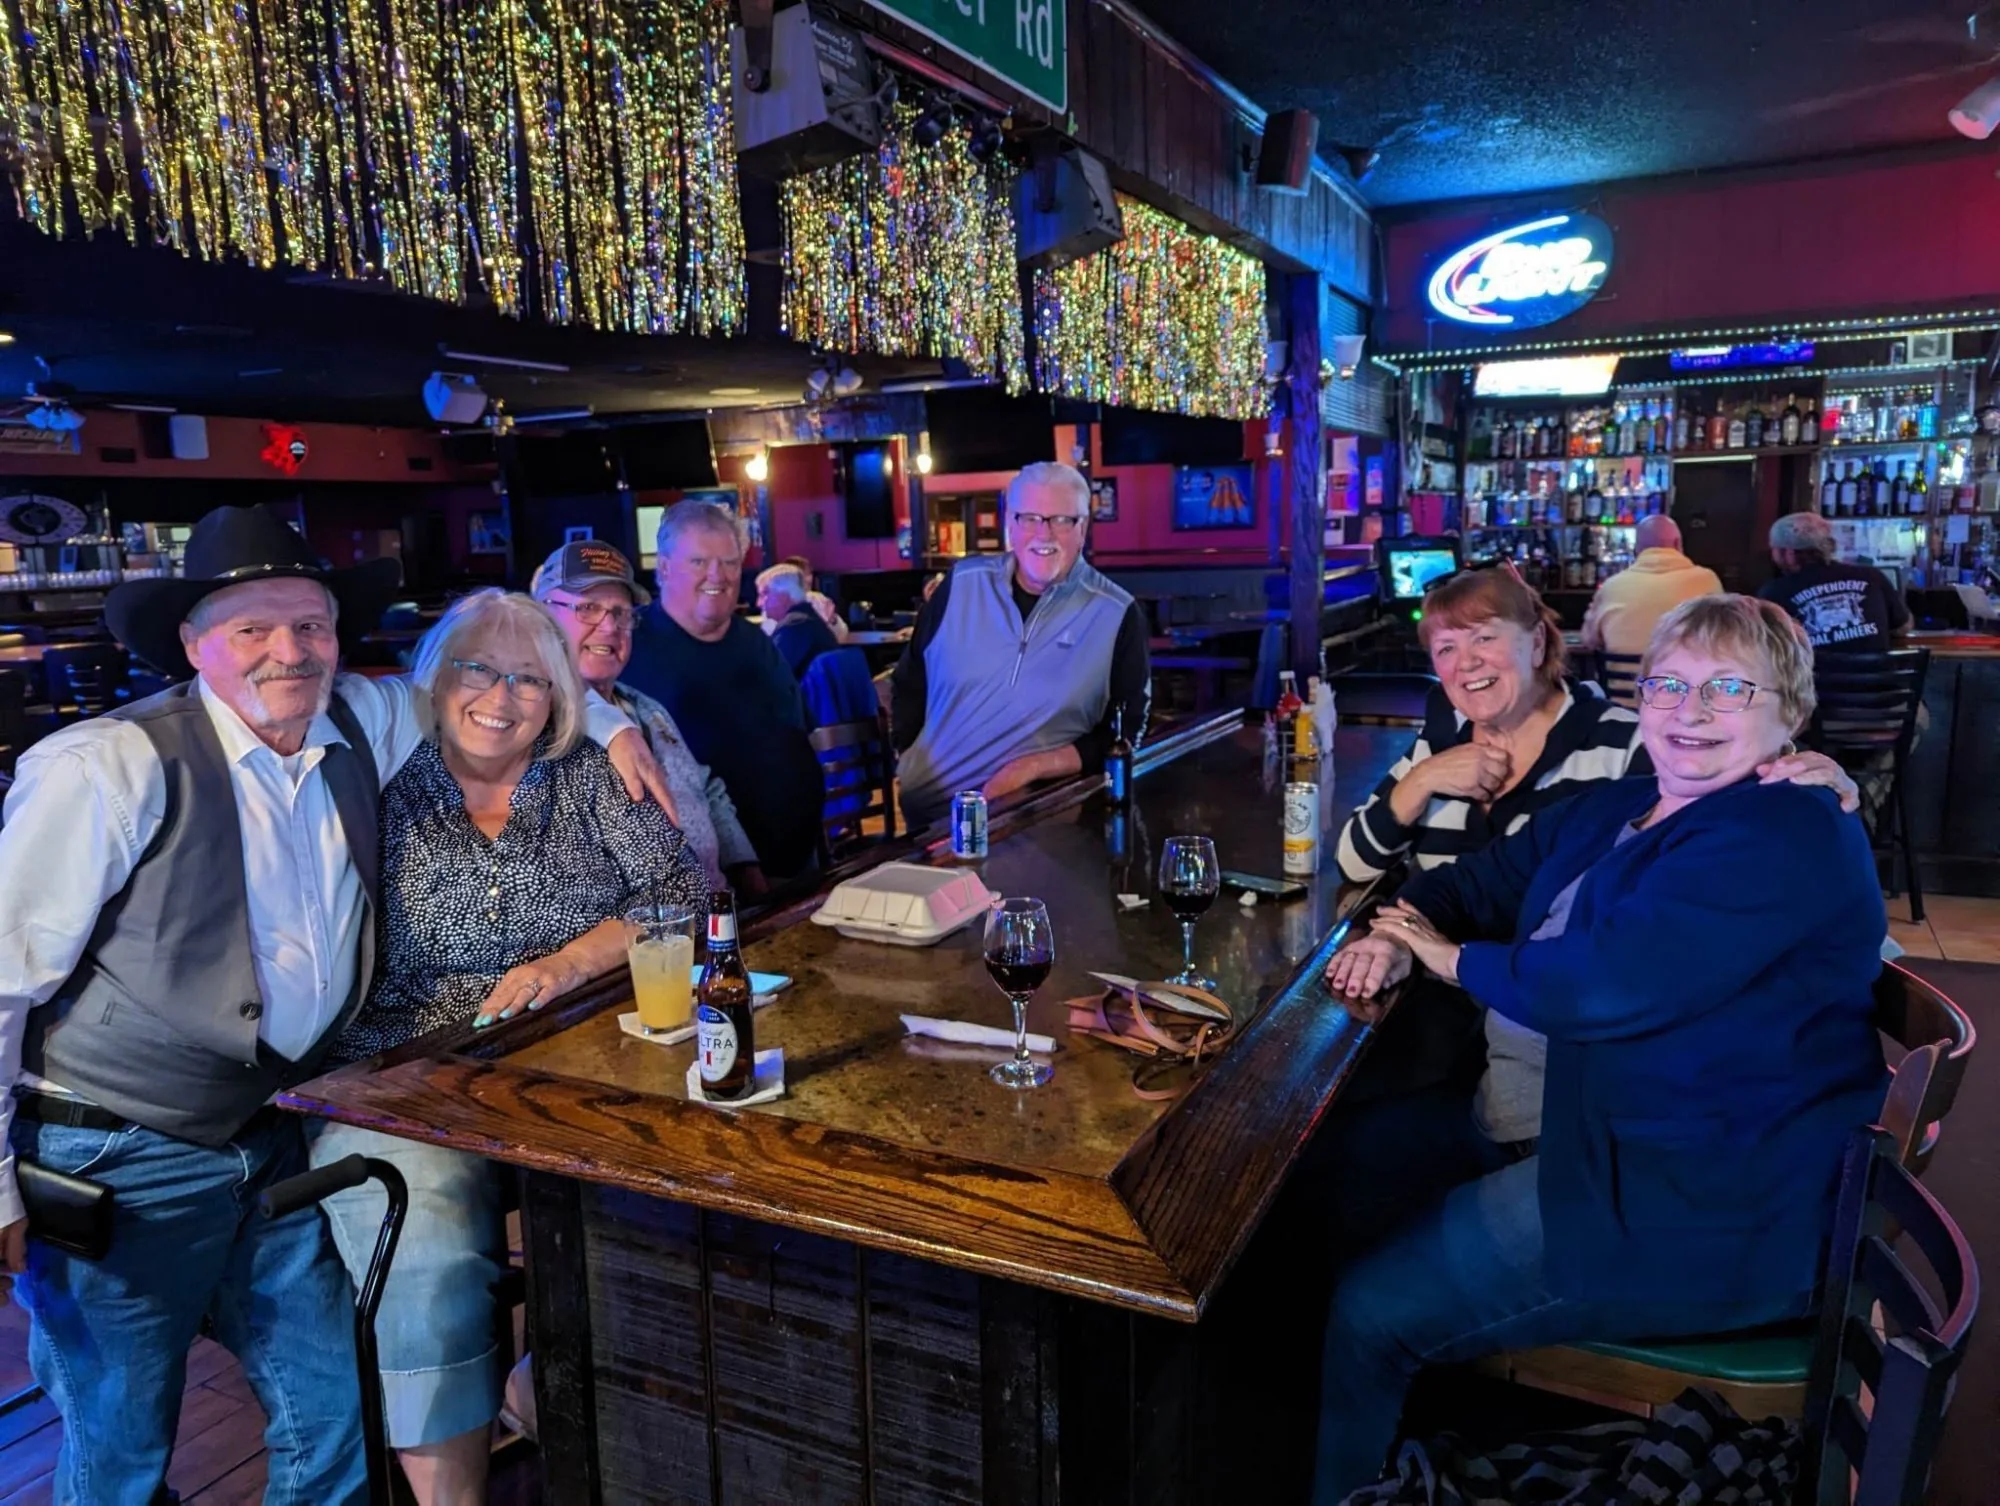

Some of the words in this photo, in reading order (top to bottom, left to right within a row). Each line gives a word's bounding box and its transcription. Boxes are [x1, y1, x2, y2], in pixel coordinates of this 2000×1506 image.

[1016, 0, 1053, 70] Rd
[1790, 580, 1869, 606] INDEPENDENT
[1808, 634, 1832, 648] OAL
[1834, 622, 1879, 642] MINERS
[700, 1036, 734, 1049] LTRA
